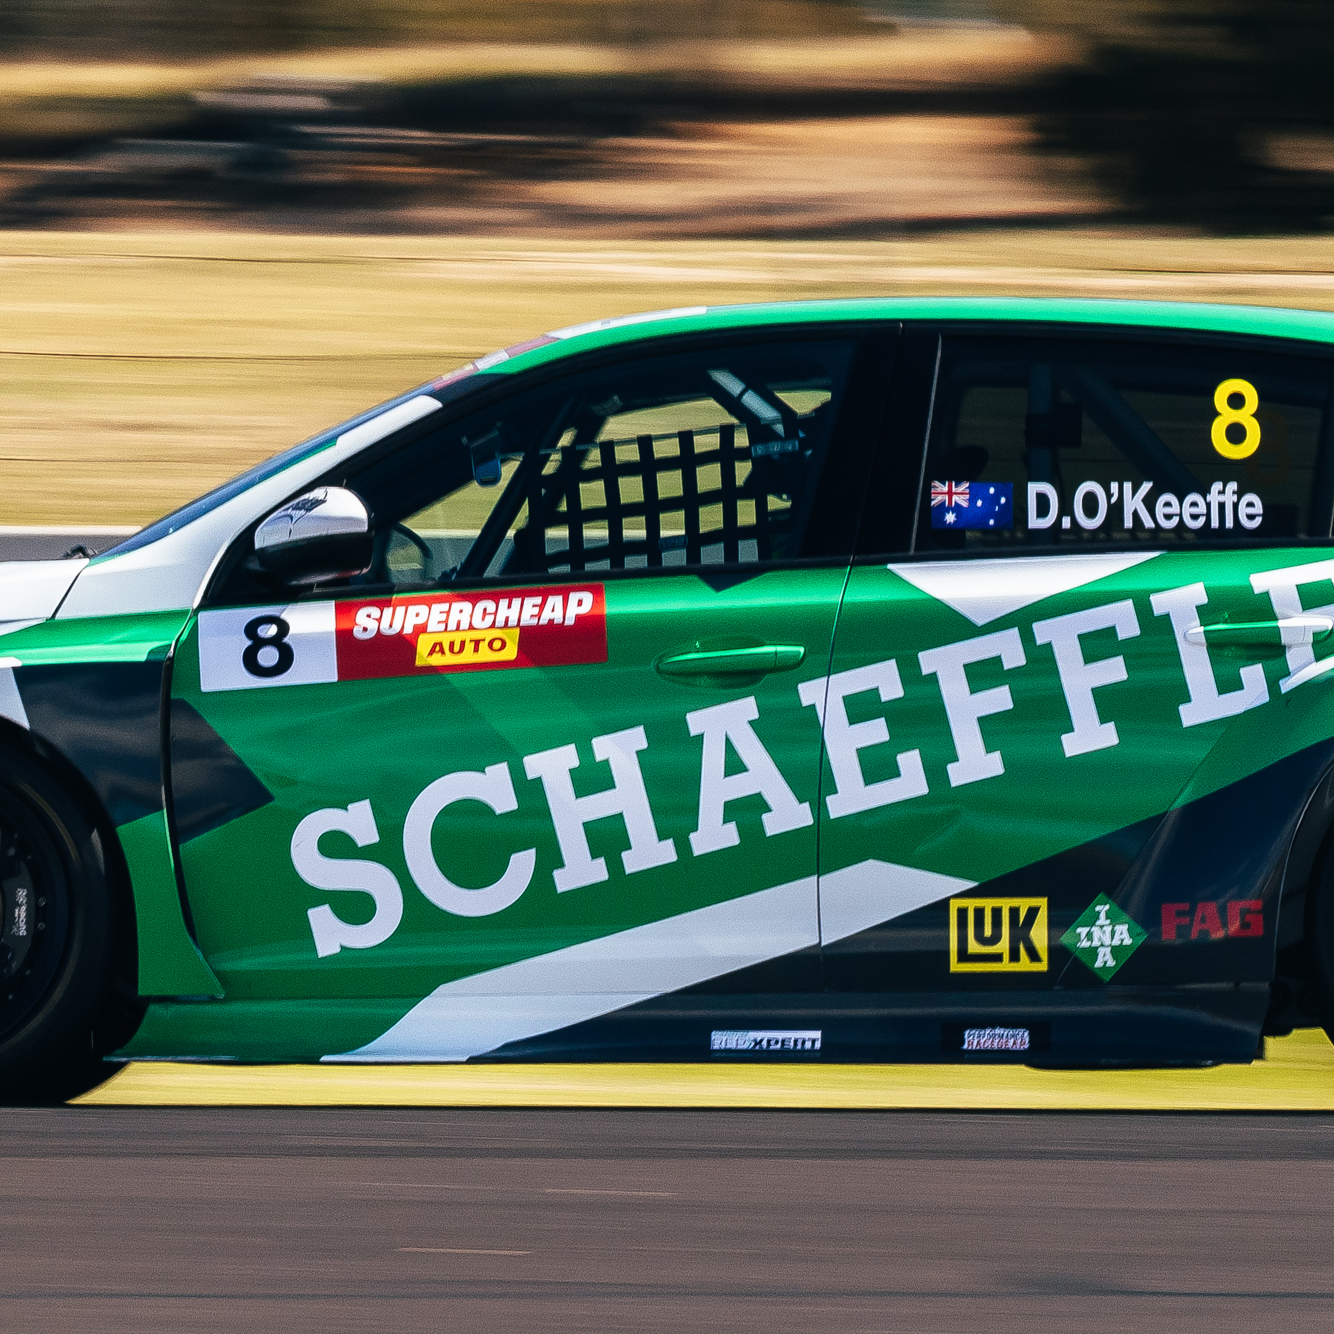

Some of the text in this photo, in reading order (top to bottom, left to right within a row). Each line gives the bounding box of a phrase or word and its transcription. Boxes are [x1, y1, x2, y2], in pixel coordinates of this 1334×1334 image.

[1211, 378, 1261, 460] 8
[352, 591, 594, 641] SUPERCHEAP
[242, 614, 295, 678] 8
[426, 636, 507, 659] AUTO
[1161, 899, 1265, 941] FAG
